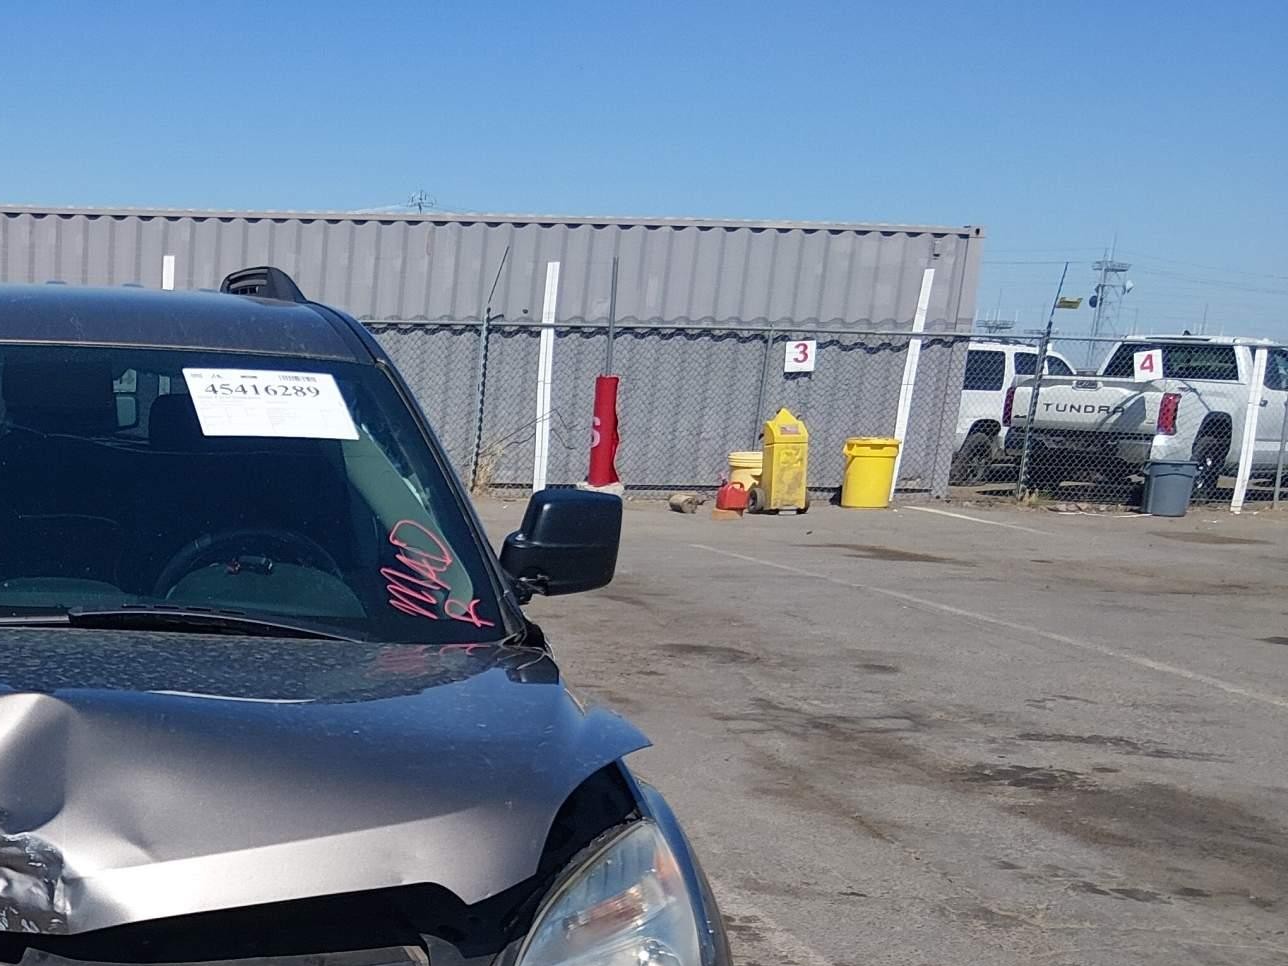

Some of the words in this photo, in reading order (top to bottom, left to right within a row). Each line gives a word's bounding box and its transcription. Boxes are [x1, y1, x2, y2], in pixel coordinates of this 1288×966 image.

[793, 342, 809, 364] 3
[1139, 353, 1155, 374] 4
[205, 383, 321, 398] 45416289
[1043, 402, 1126, 415] TUNDRA
